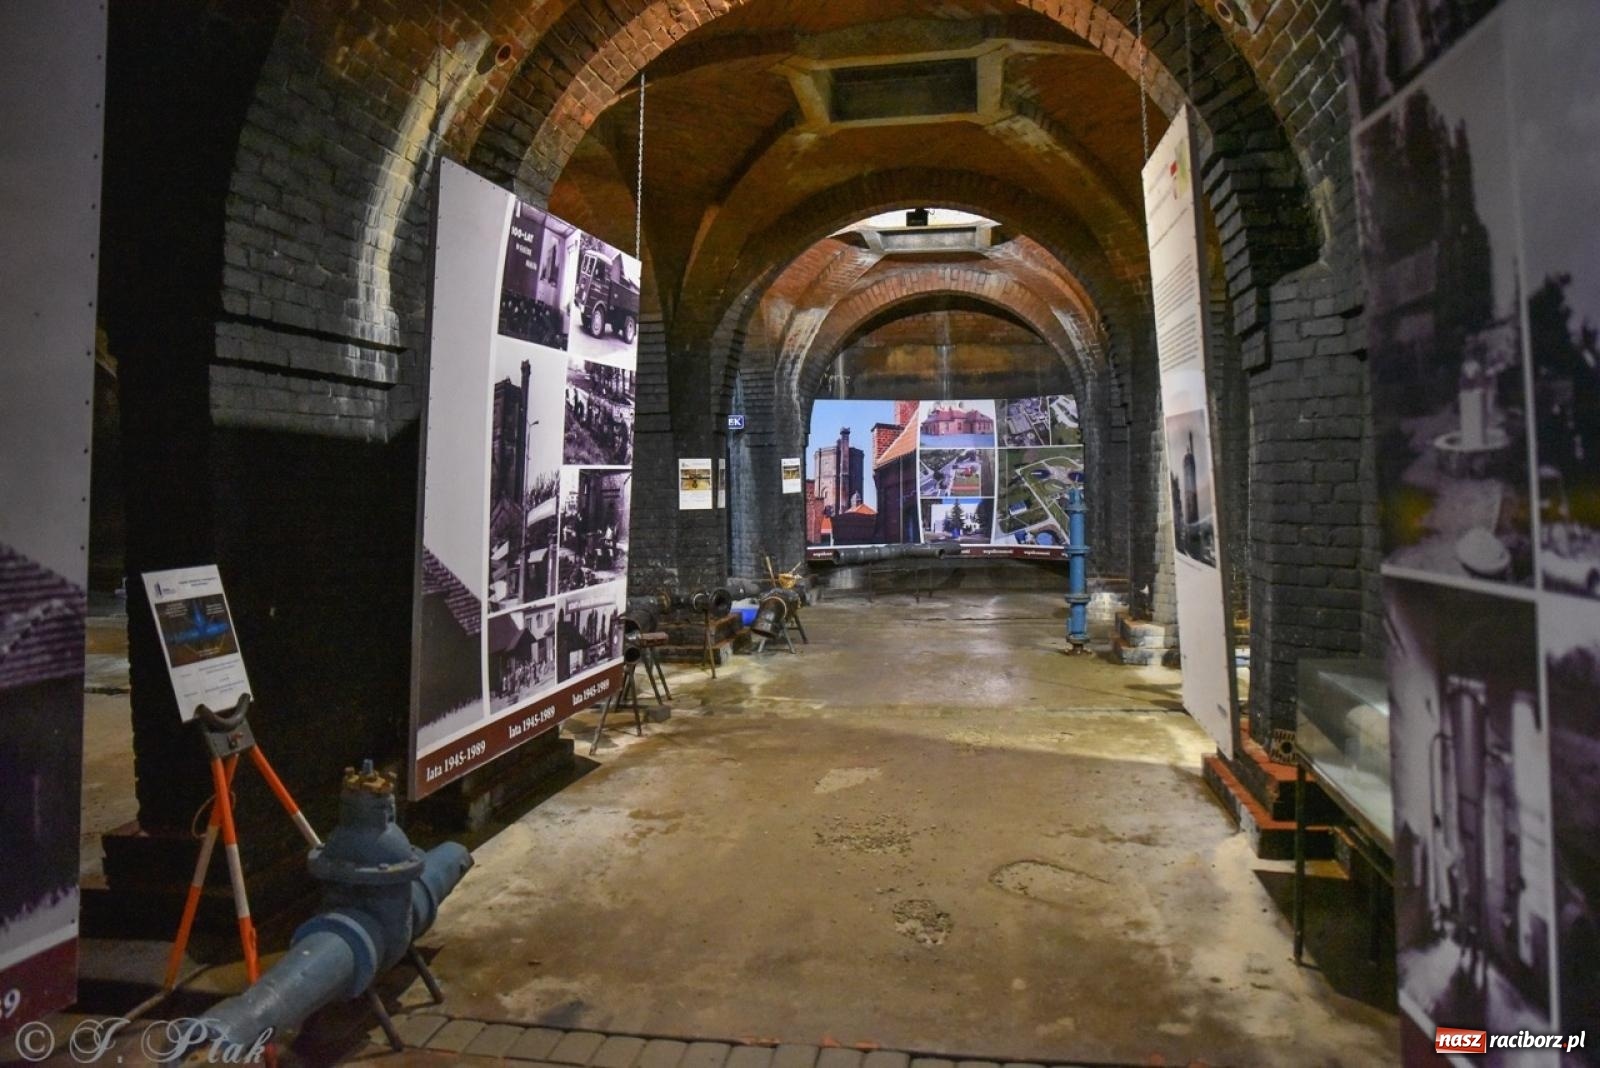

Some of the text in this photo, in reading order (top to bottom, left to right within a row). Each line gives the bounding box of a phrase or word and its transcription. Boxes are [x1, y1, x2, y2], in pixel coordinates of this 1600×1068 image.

[508, 705, 556, 739] lata 1945-1989
[426, 740, 486, 782] lata 1945-1989
